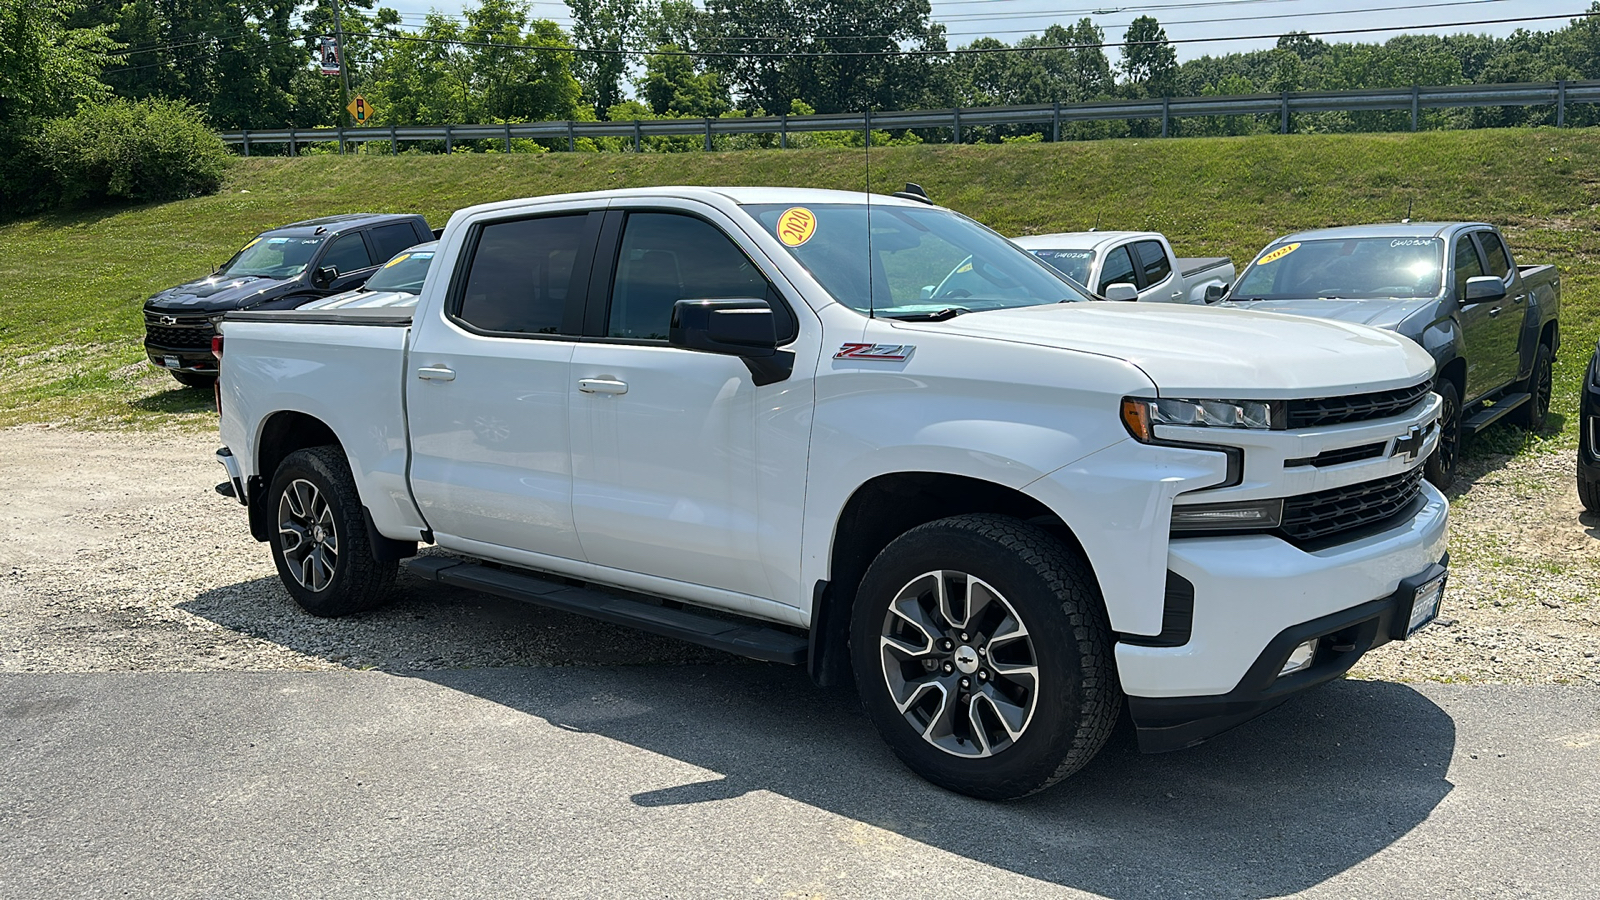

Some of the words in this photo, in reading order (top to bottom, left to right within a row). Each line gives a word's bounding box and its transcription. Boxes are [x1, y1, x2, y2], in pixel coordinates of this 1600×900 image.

[783, 210, 811, 242] 2020
[1265, 245, 1293, 262] 2021
[834, 343, 917, 362] Z71
